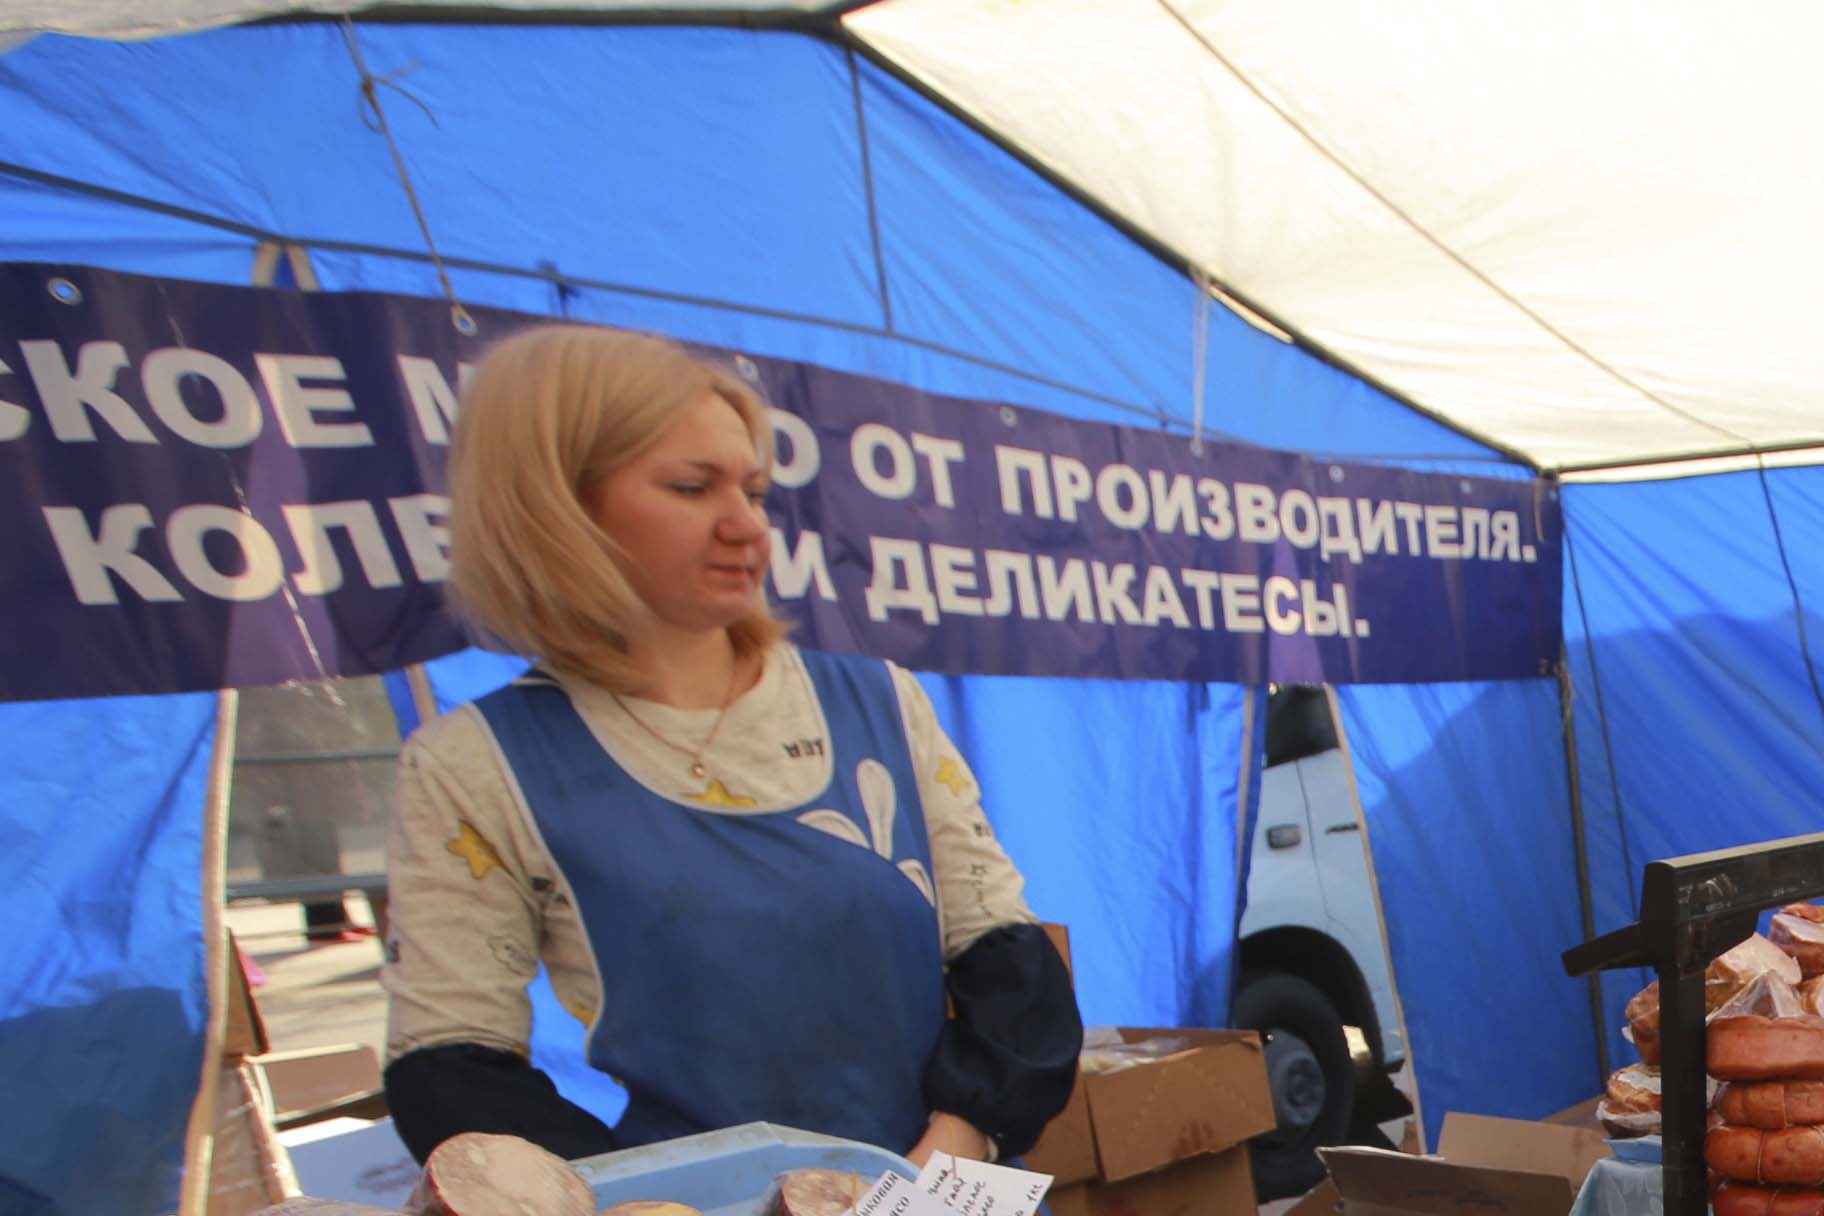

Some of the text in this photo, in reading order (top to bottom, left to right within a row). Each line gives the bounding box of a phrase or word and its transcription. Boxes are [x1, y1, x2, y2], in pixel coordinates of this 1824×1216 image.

[850, 423, 963, 510] ОТ
[994, 444, 1536, 564] ПРОИЗВОДИТЕЛЯ.
[866, 535, 1370, 639] ДЕЛИКАТЕСЫ.
